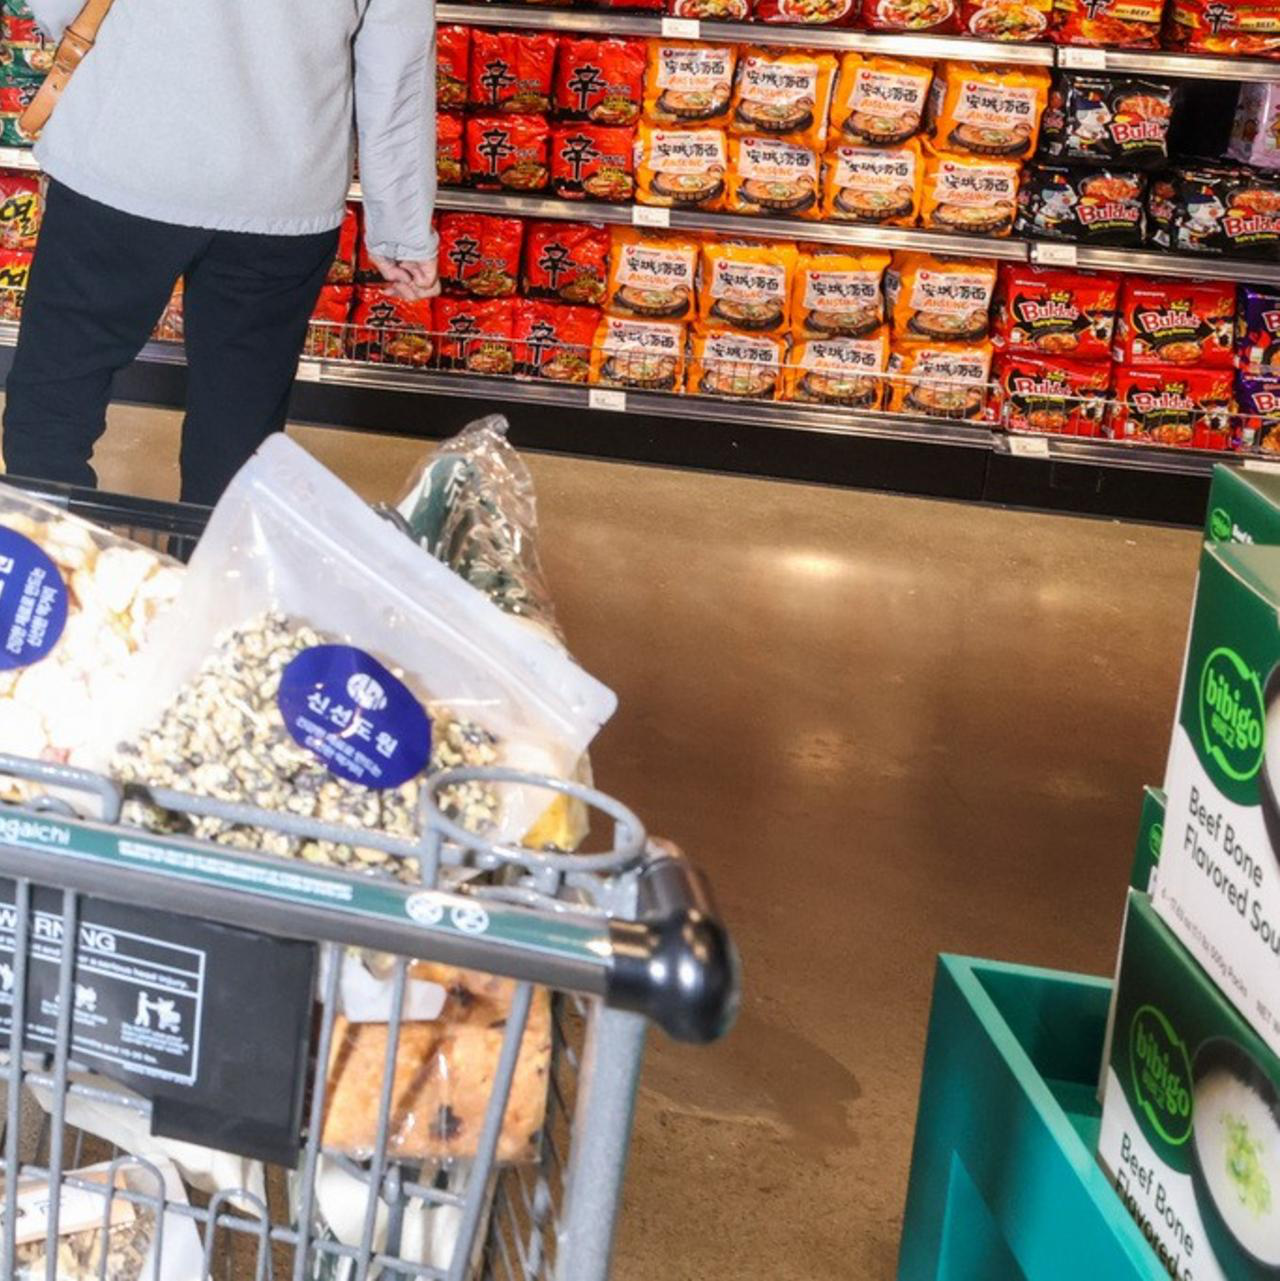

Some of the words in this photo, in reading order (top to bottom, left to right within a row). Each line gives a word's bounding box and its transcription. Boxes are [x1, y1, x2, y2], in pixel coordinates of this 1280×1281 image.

[1204, 2, 1236, 35] 辛
[481, 59, 516, 106] 辛
[569, 64, 606, 112] 辛
[479, 128, 516, 177] 辛
[561, 134, 601, 184] 辛
[306, 691, 399, 759] 신선도원
[1205, 668, 1261, 752] bibigo
[1189, 785, 1224, 843] Beef
[1223, 820, 1264, 889] Bone
[1183, 822, 1249, 918] Flavored
[1250, 900, 1280, 958] Sou
[1136, 1022, 1190, 1118] bibigo
[1120, 1131, 1155, 1196] Beef
[1154, 1181, 1195, 1259] Bone
